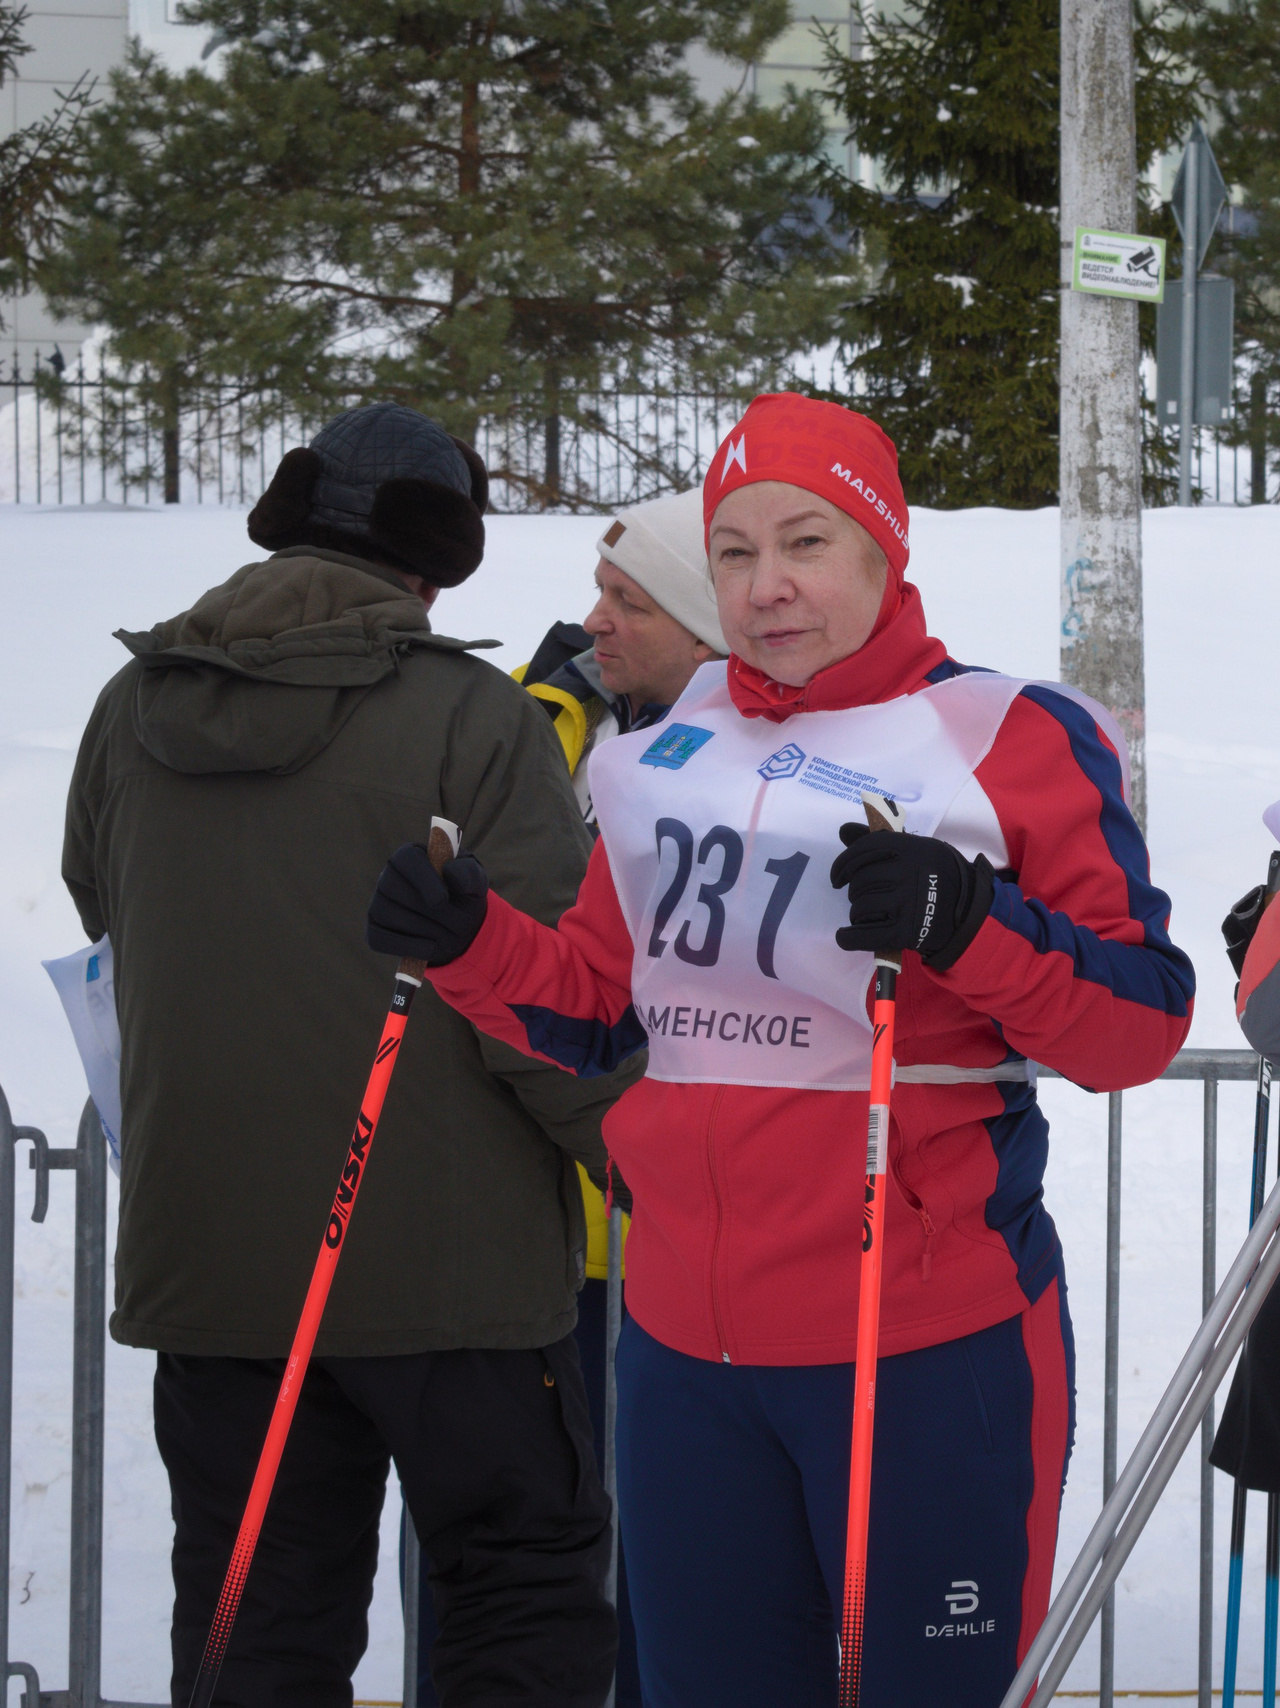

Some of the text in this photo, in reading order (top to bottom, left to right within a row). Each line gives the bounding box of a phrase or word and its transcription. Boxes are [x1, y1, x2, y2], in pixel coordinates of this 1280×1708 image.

[1082, 263, 1114, 273] ВЕДЕТСЯ
[831, 462, 909, 550] MADSHUS
[802, 770, 854, 794] АДМИНИСТРАЦИИ
[807, 763, 897, 801] И МОЛОДЕЖНОЙ ПОЛИТИКЕ
[811, 756, 879, 785] КОМИТЕТ ПО СПОРТУ
[648, 817, 811, 981] 231
[393, 994, 406, 1007] 135
[635, 1003, 812, 1049] МЕНСКОЕ
